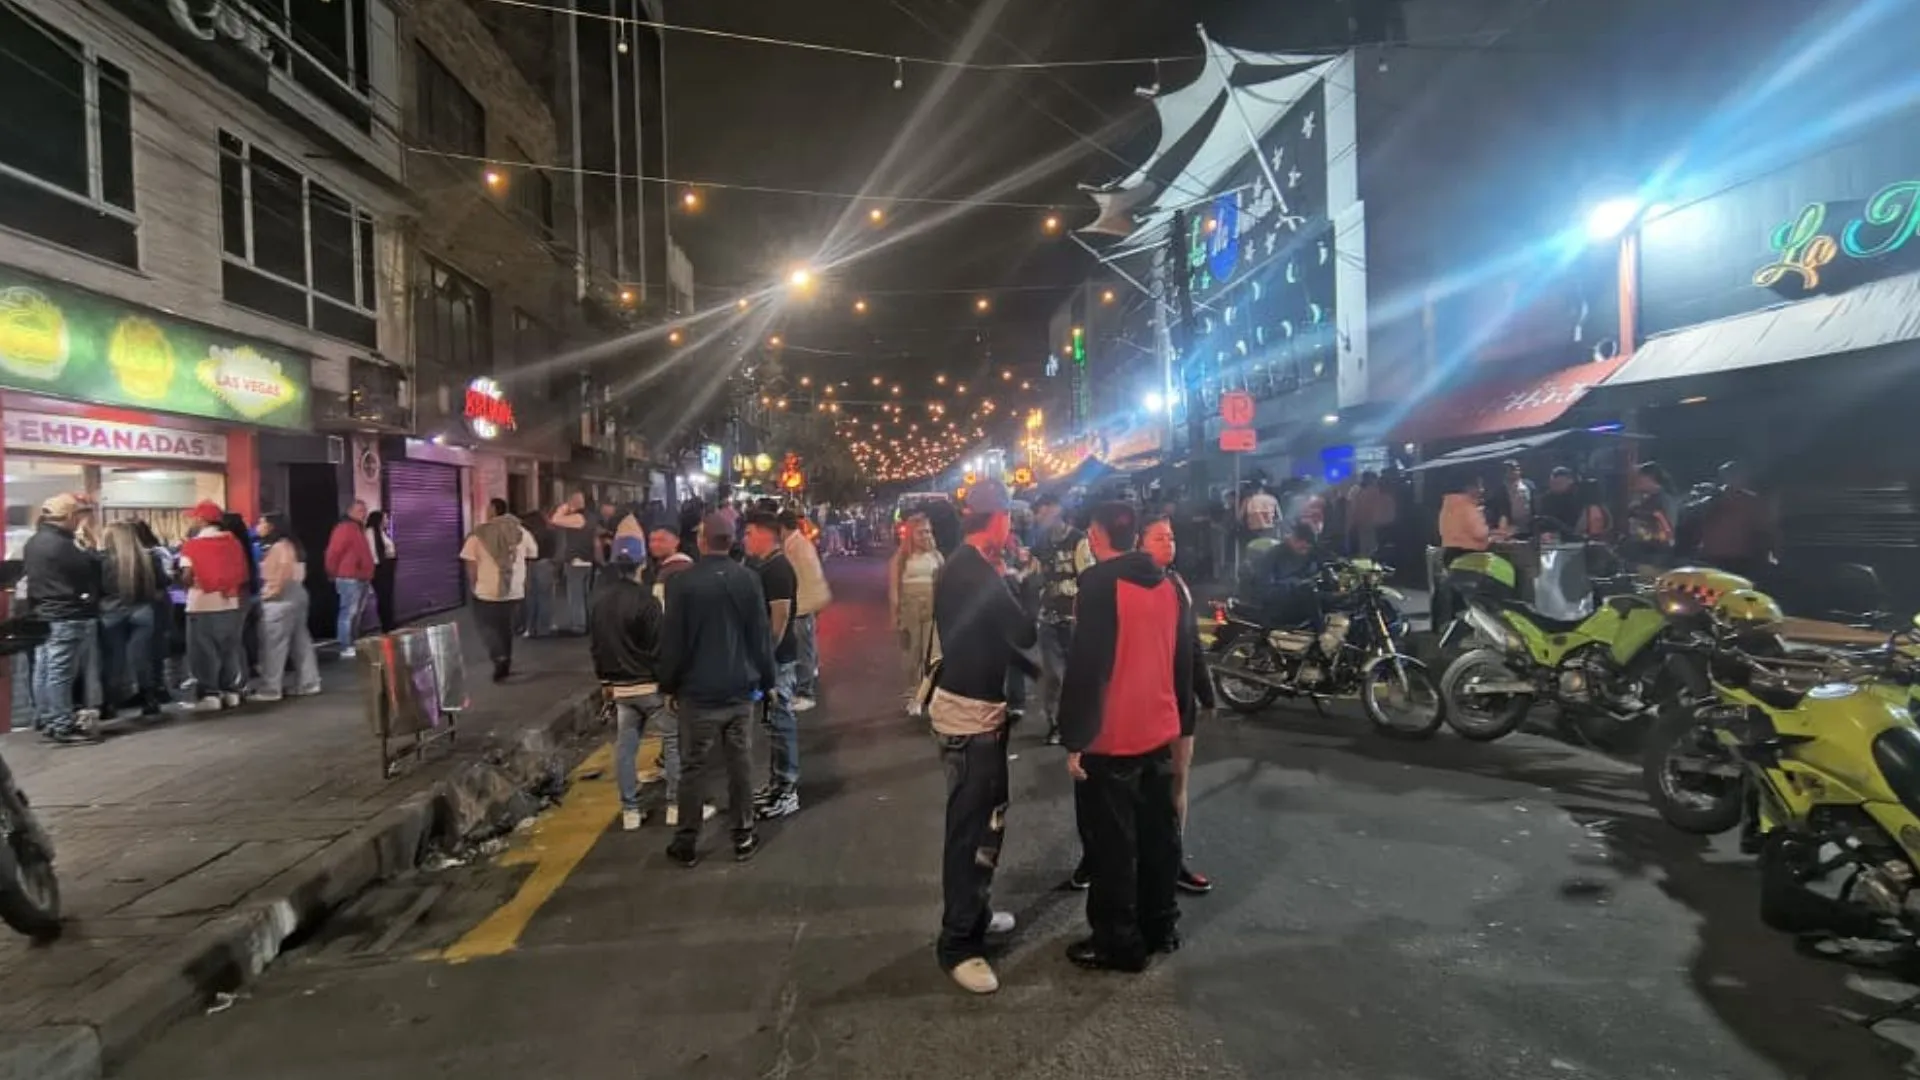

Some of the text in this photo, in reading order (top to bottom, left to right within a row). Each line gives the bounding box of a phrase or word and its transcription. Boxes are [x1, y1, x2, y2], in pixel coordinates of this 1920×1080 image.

[216, 373, 280, 397] LAS VEGAS
[18, 419, 205, 457] EMPANADAS
